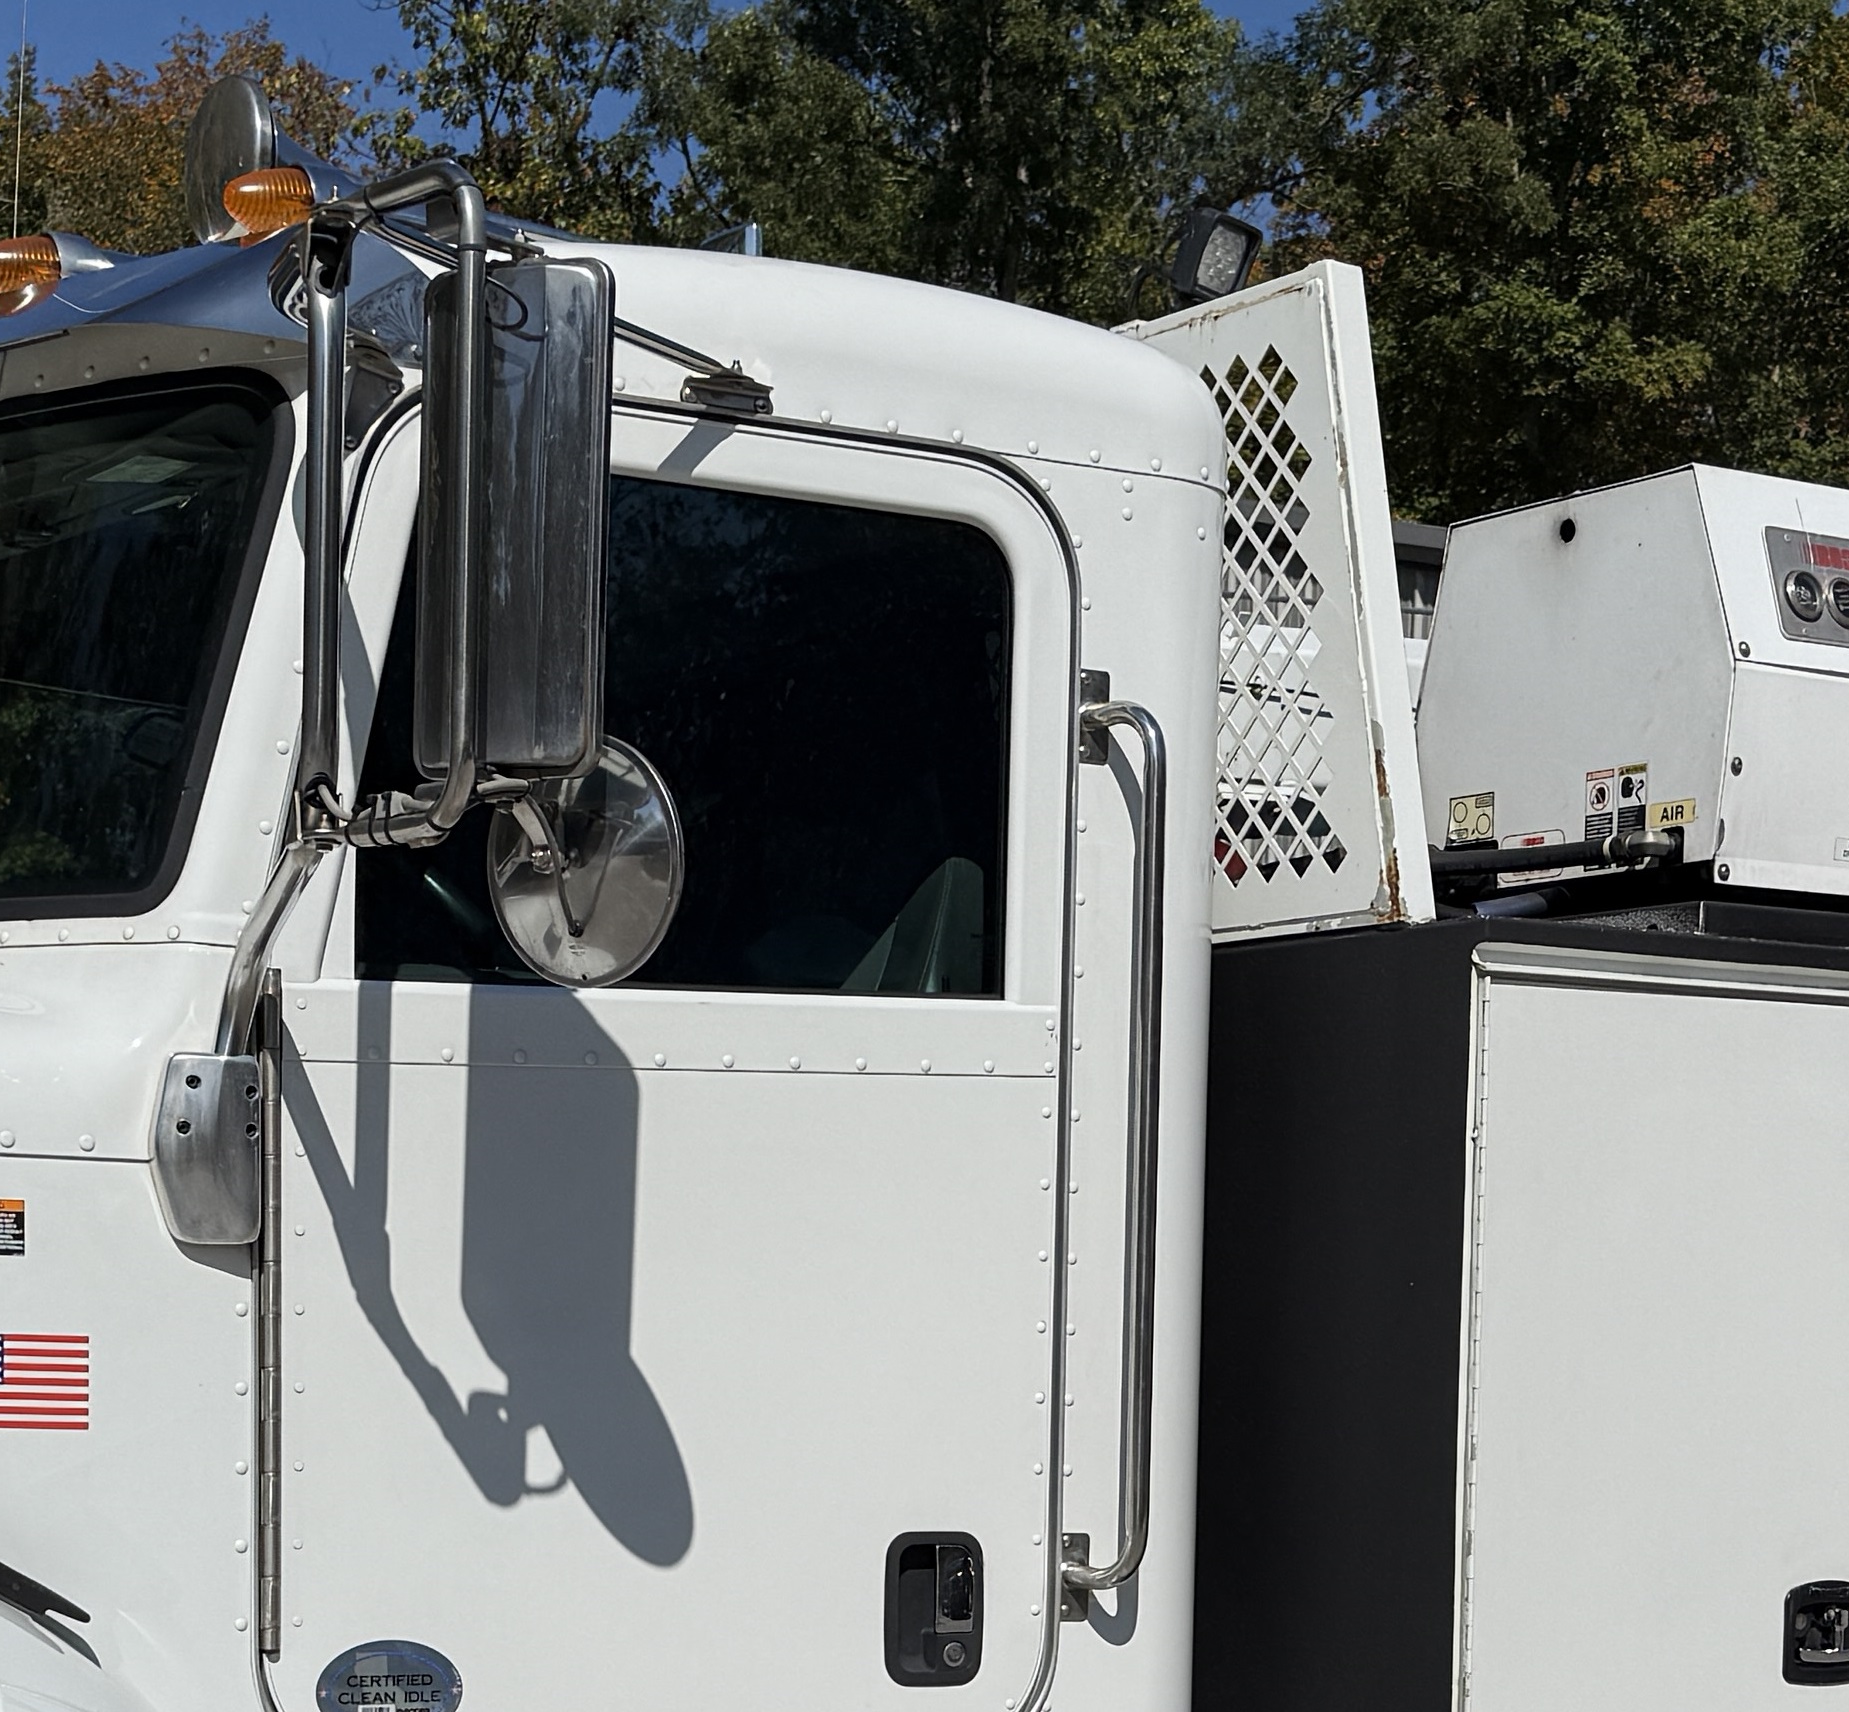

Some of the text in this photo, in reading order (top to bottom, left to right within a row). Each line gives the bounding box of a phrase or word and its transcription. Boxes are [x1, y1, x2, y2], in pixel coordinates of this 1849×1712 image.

[1660, 805, 1684, 823] AIR
[347, 1674, 433, 1688] CERTIFIED
[338, 1690, 442, 1705] CLEAN IDLE
